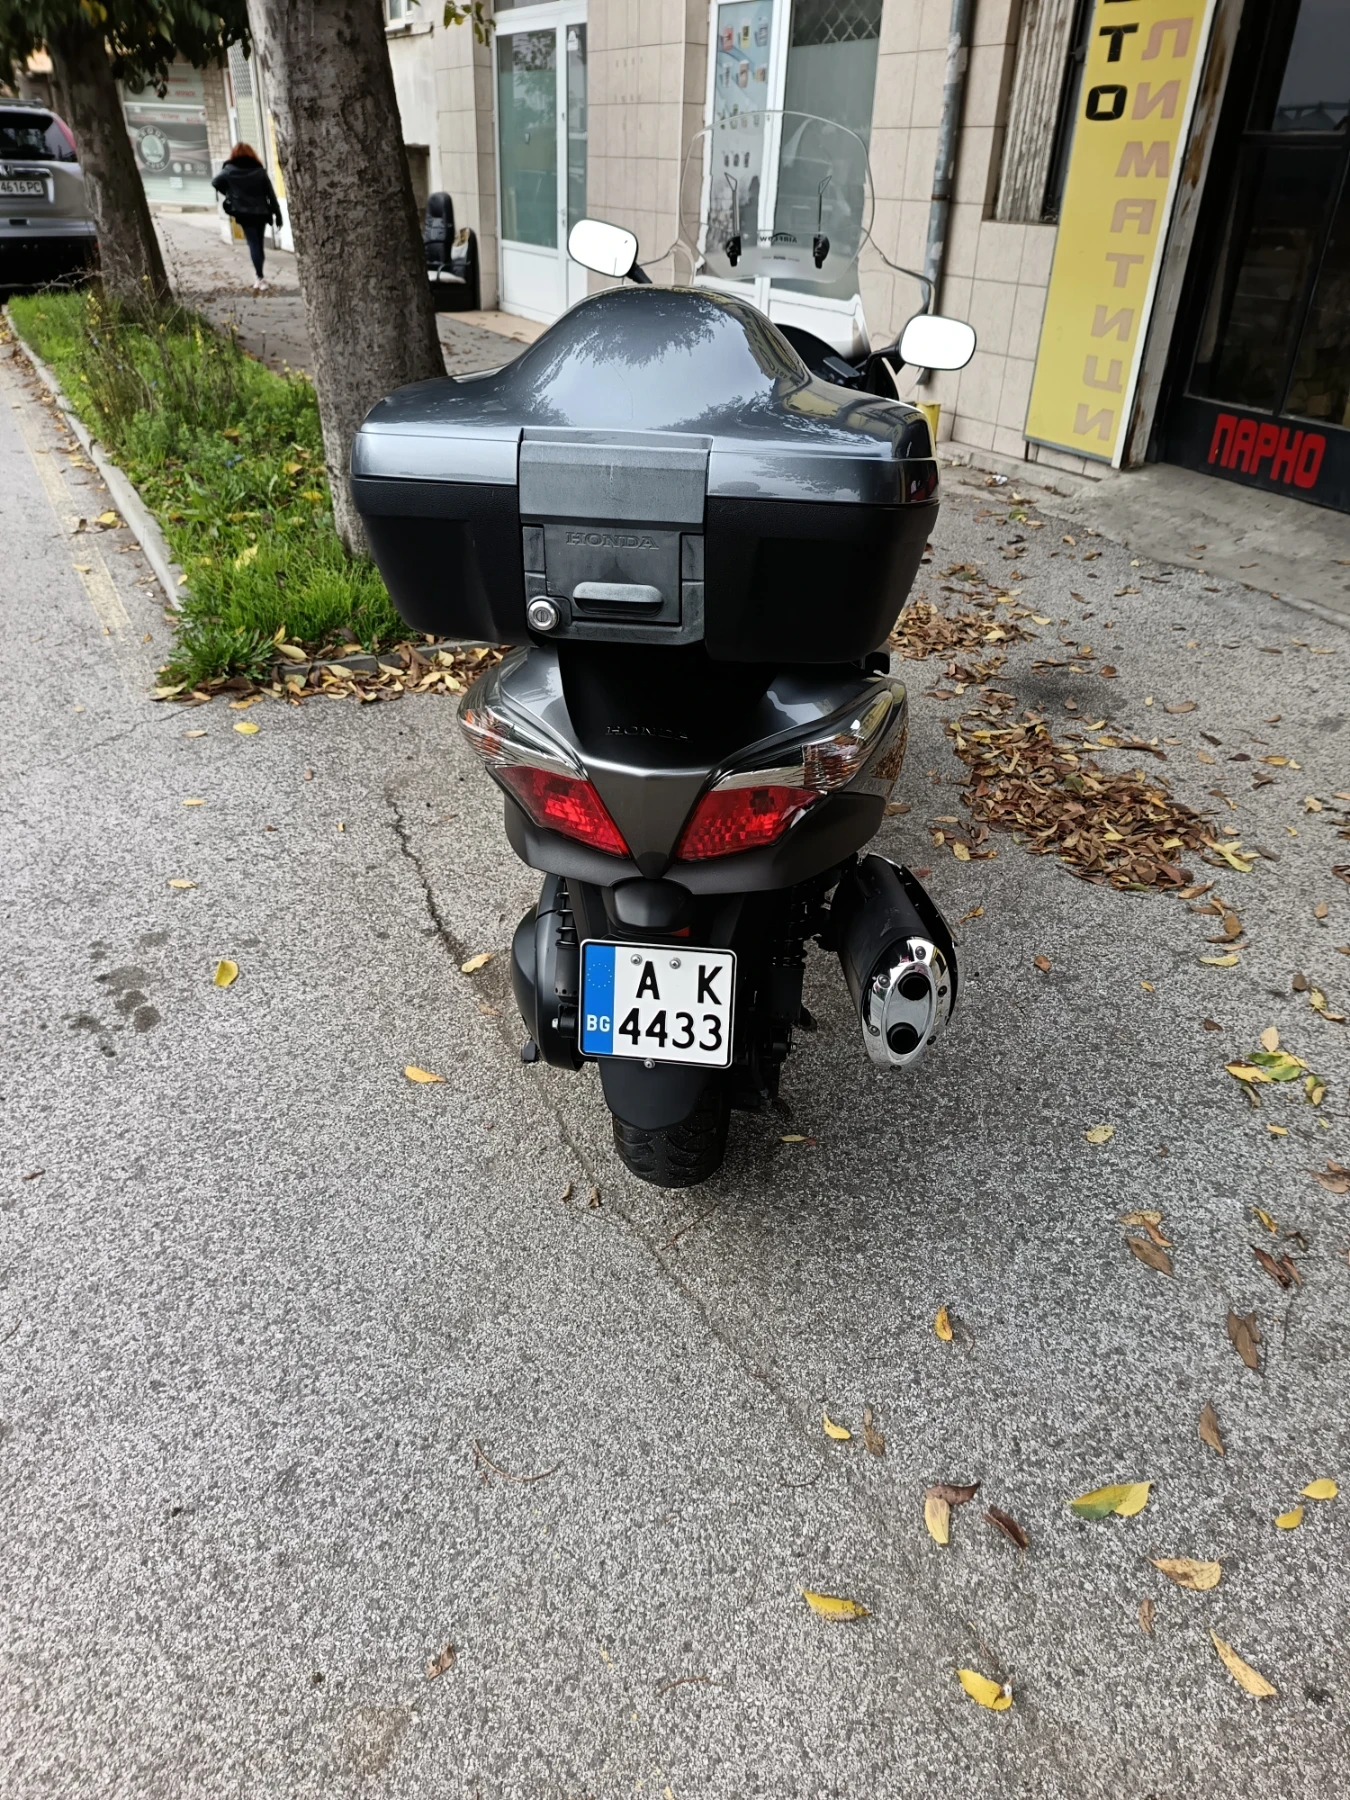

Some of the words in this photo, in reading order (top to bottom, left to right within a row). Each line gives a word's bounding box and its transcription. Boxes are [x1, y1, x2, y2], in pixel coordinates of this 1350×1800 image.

[1085, 0, 1142, 121] ТО
[1207, 413, 1326, 489] ПАРНО
[565, 531, 660, 550] HONDA
[605, 726, 694, 743] HONDA
[635, 960, 661, 1000] A
[697, 964, 723, 1006] K
[586, 1014, 611, 1033] BG
[618, 1007, 723, 1051] 4433
